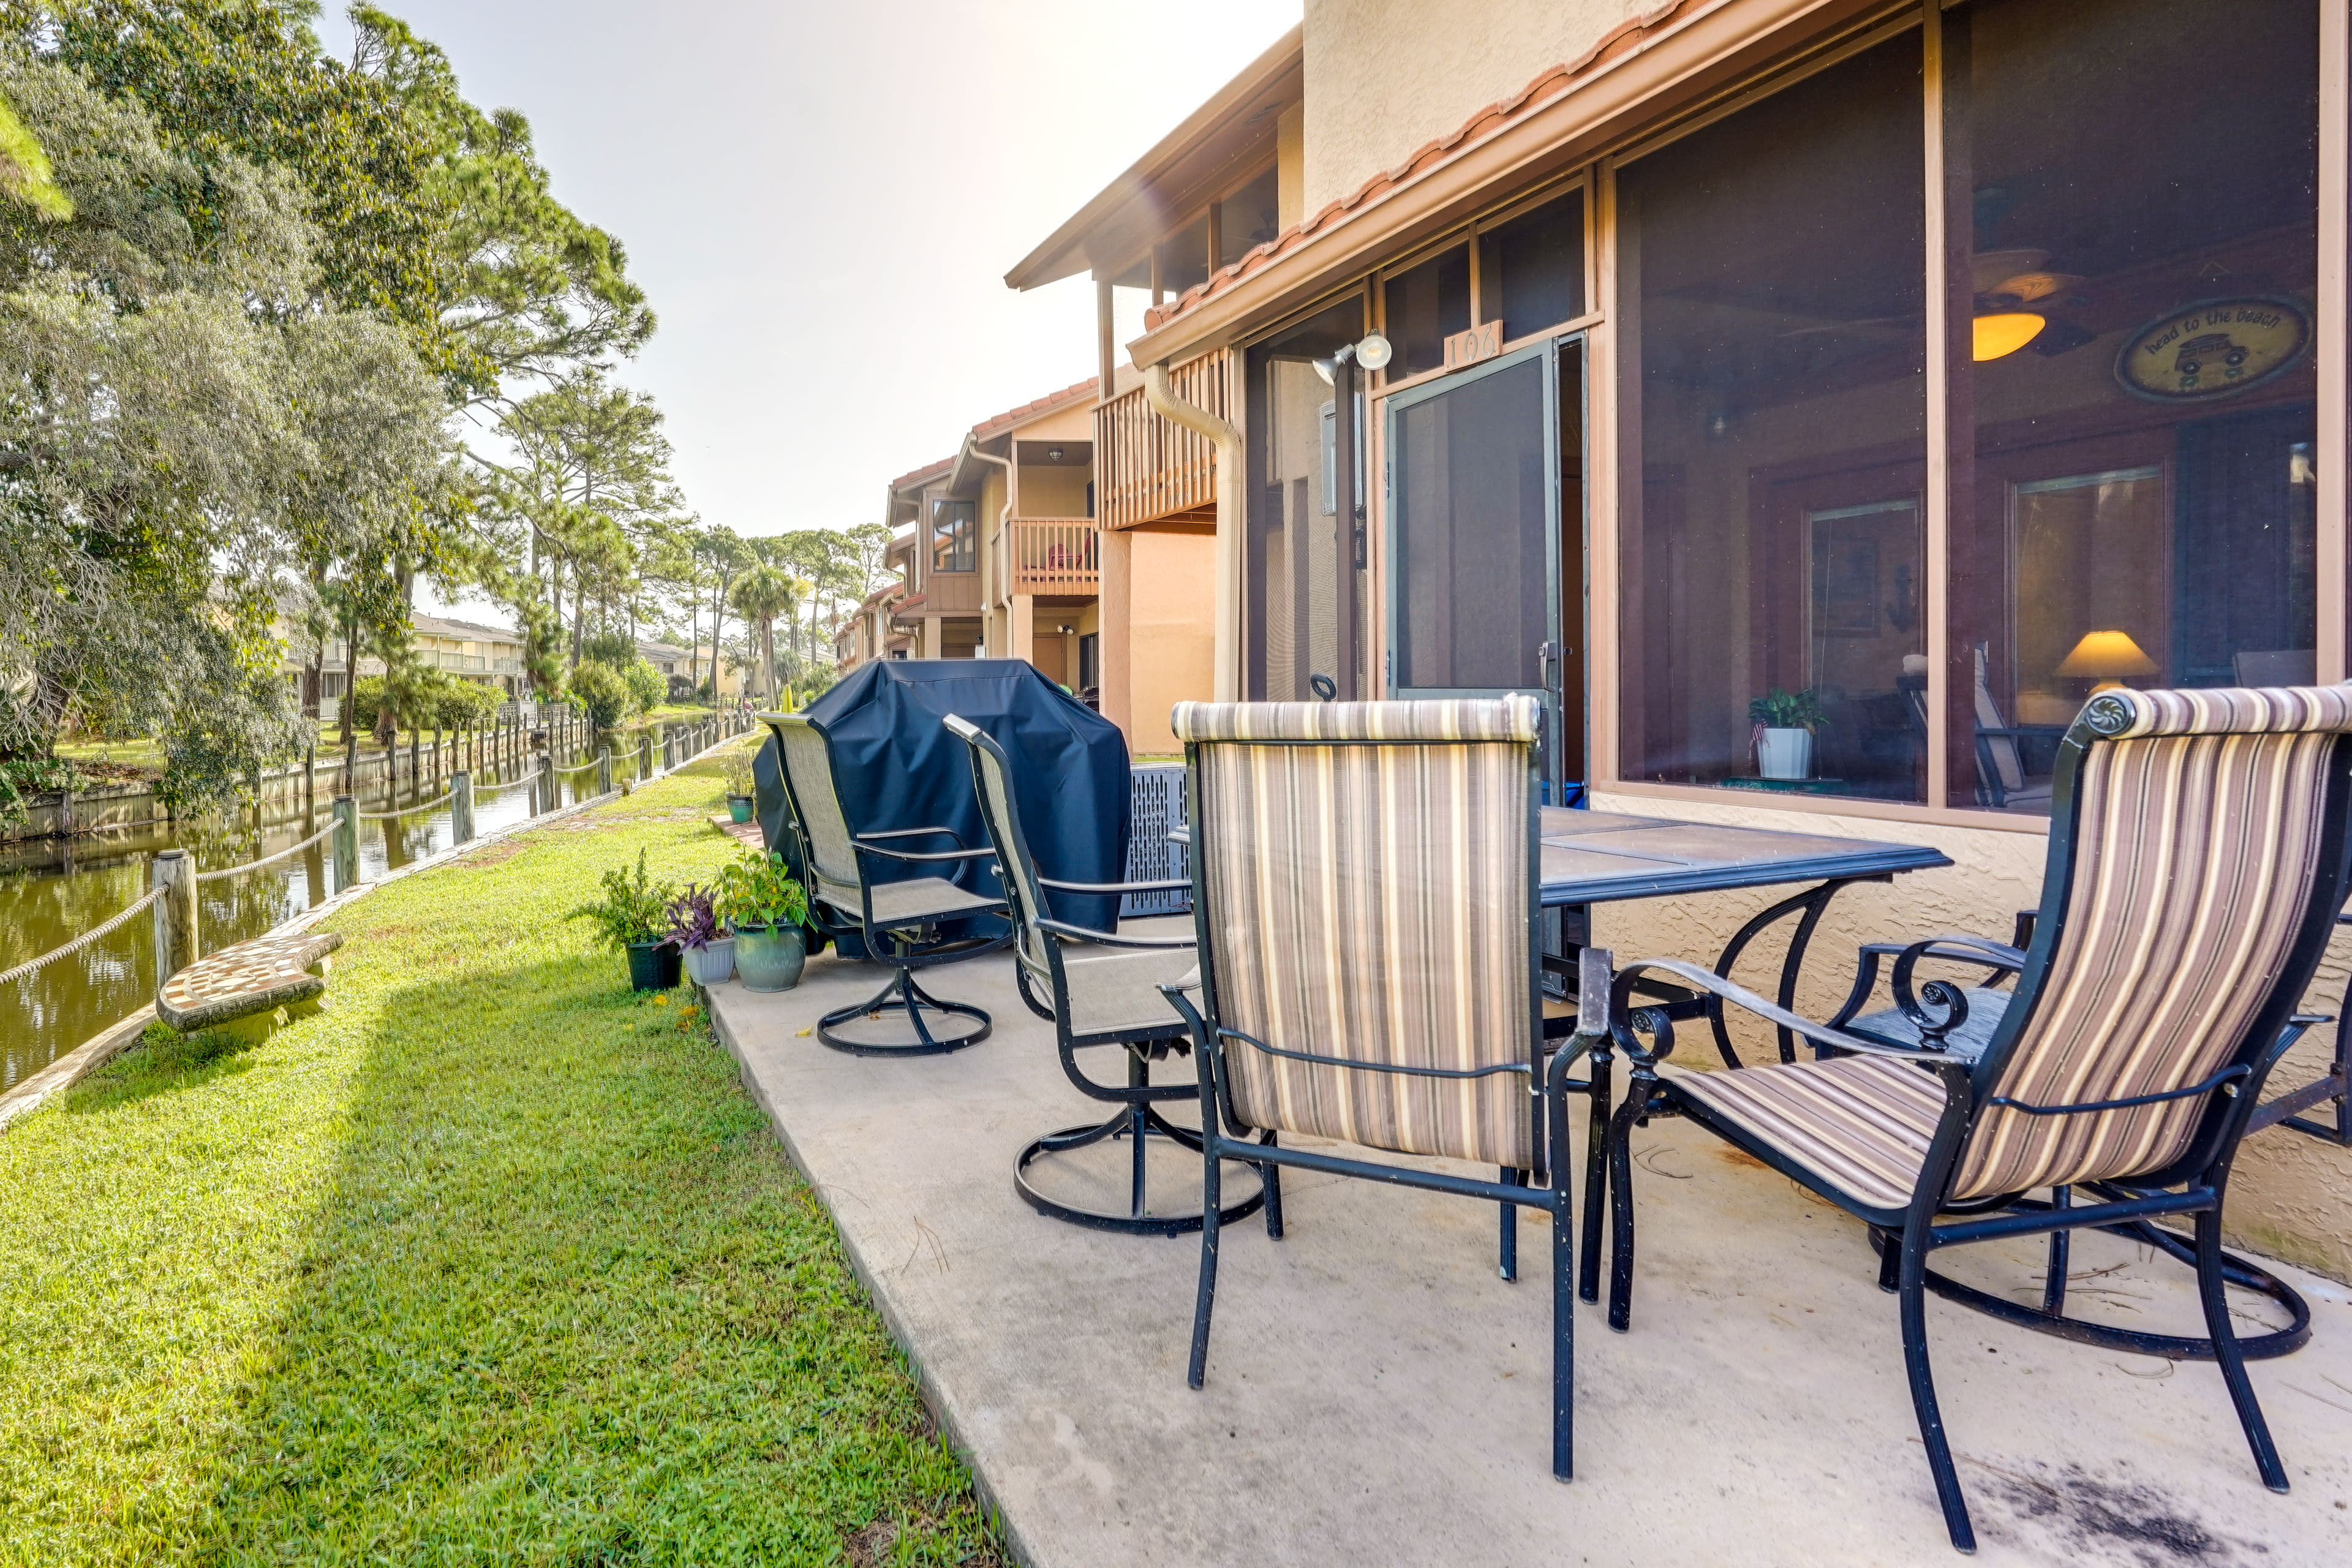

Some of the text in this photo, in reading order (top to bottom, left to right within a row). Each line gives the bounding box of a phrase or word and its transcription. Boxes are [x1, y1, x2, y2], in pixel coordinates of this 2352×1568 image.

[1450, 323, 1494, 369] 106
[2146, 307, 2281, 355] head to the beach
